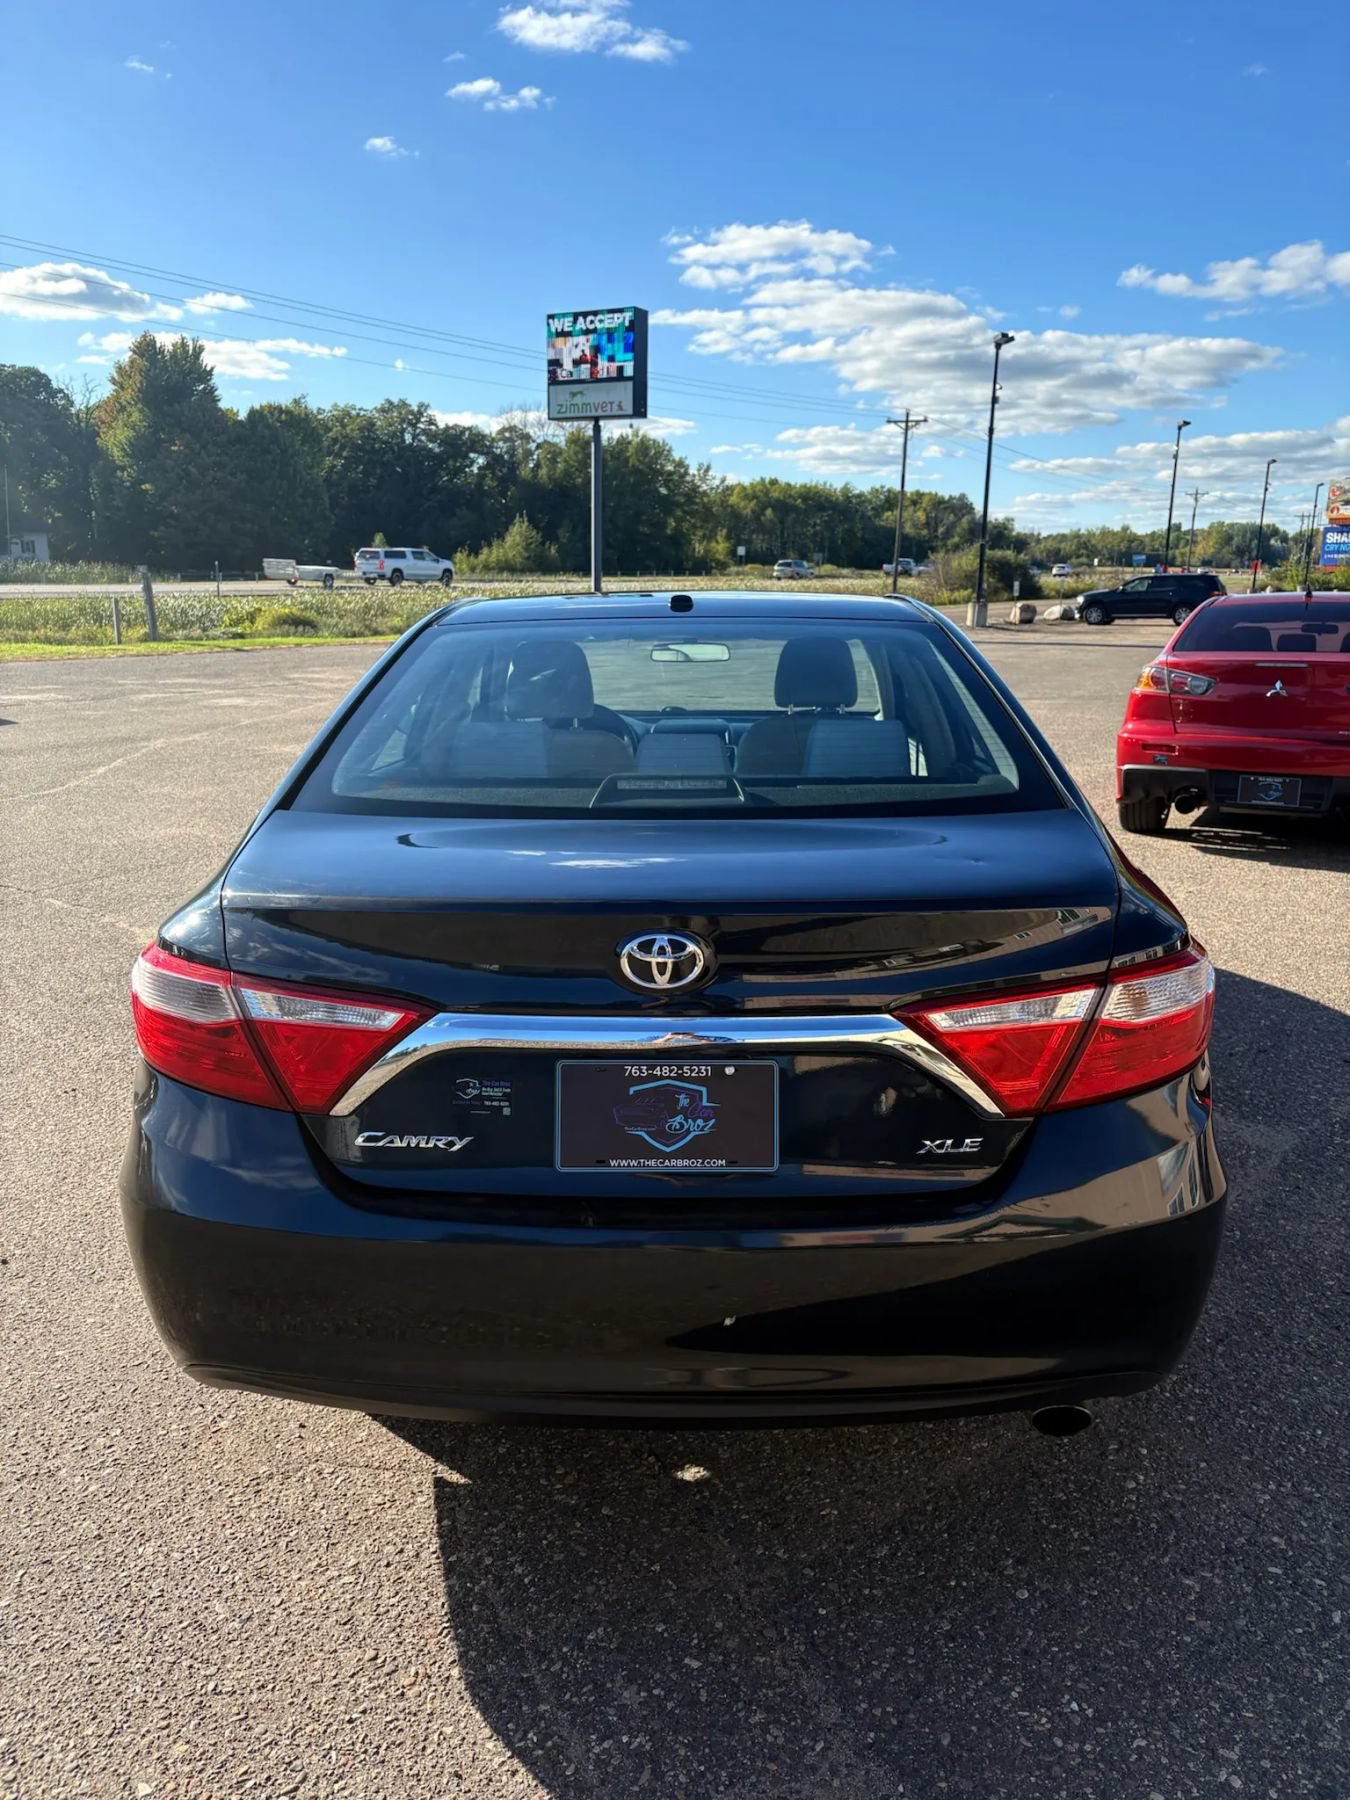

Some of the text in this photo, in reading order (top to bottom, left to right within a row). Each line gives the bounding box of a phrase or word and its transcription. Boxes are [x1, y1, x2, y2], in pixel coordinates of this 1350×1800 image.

[548, 312, 633, 332] WE ACCEPT
[1326, 532, 1350, 543] SHA
[624, 1066, 712, 1077] 763-482-5231
[665, 1114, 717, 1133] Broz
[354, 1131, 475, 1152] CAMRY
[916, 1138, 984, 1154] XLE
[609, 1158, 726, 1167] WWW.THECARBROZ.COM
